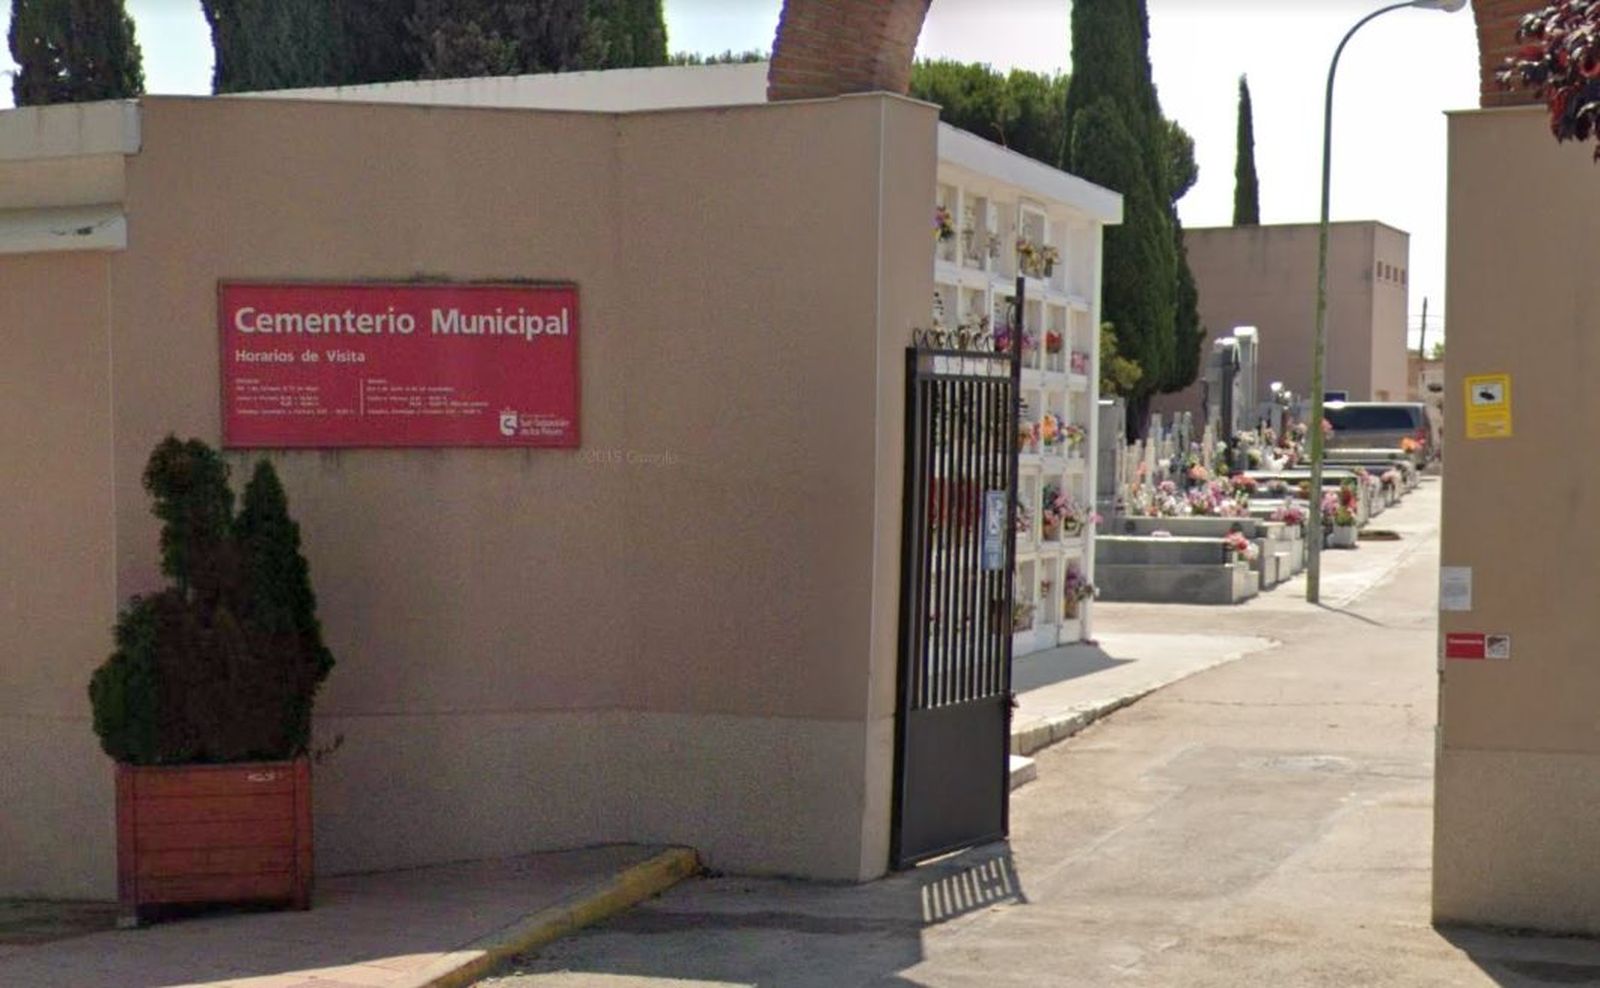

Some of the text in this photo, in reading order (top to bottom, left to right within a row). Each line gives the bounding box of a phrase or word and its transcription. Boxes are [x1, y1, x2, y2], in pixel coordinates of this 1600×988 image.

[235, 307, 568, 341] Cementerio Municipal
[235, 350, 365, 362] Horarios de Visita
